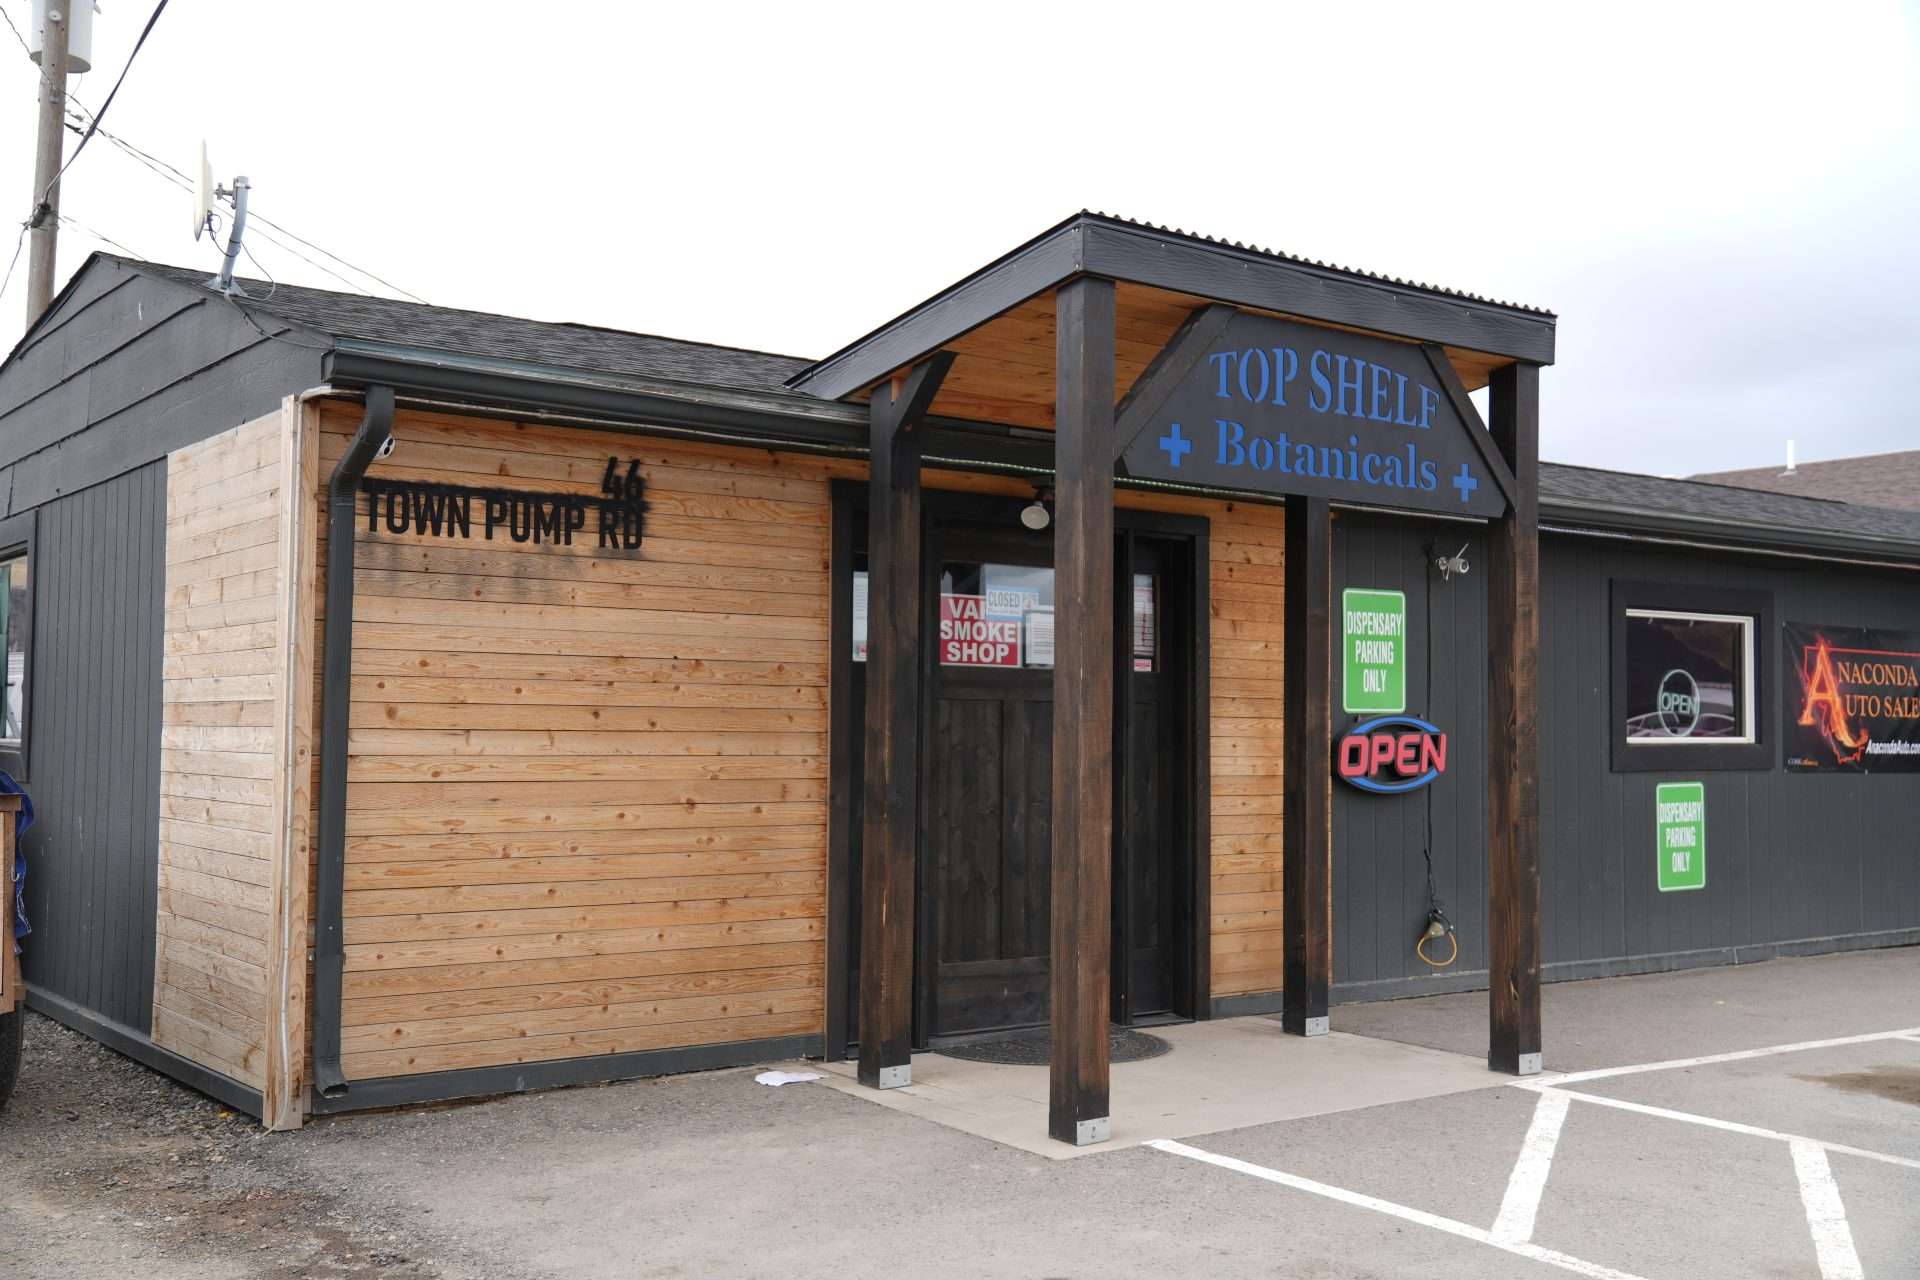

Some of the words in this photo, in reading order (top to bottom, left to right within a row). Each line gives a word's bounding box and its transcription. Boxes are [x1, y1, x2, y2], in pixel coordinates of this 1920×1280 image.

[1209, 347, 1299, 406] TOP
[1309, 349, 1440, 429] SHELF
[1215, 418, 1439, 492] Botanicals
[364, 489, 471, 539] TOWN
[485, 498, 585, 546] PUMP
[599, 501, 645, 550] RD
[988, 591, 1021, 608] CLOSED
[940, 620, 1017, 643] SMOKE
[1346, 611, 1402, 636] DISPENSARY
[946, 641, 1010, 663] SHOP
[1355, 639, 1394, 664] PARKING
[1362, 669, 1388, 692] ONLY
[1661, 691, 1698, 716] OPEN
[1883, 695, 1920, 718] SALE
[1337, 732, 1447, 778] OPEN
[1658, 801, 1703, 823] DISPENSARY
[1665, 826, 1696, 848] PARKING
[1672, 851, 1691, 872] ONLY
